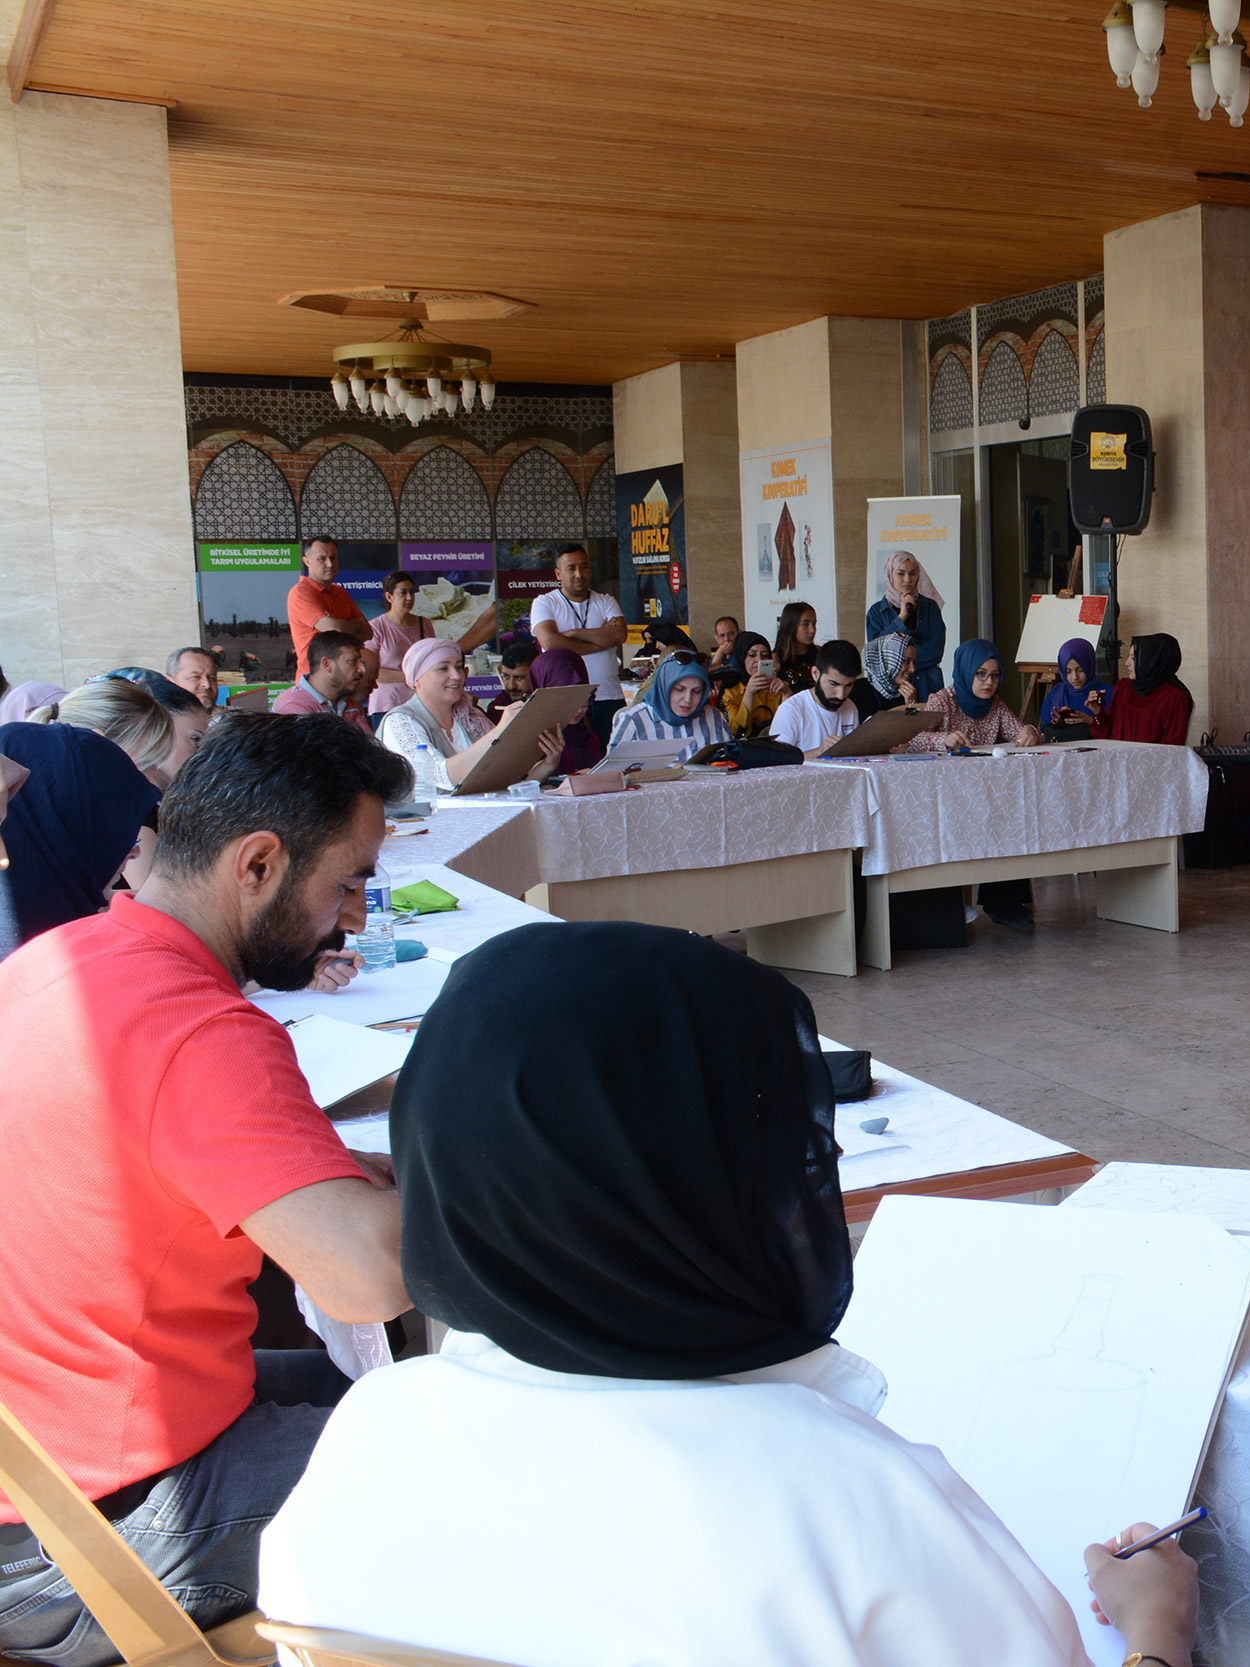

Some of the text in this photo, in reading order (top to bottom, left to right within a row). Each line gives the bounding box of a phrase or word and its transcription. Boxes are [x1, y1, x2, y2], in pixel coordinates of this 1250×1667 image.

[771, 458, 797, 478] KOMEK
[762, 474, 808, 501] KOOPERATİFİ
[895, 513, 933, 527] KOMEK
[631, 527, 670, 555] HUFFAZ
[880, 525, 948, 543] KOOPERATİFİ
[210, 547, 291, 556] BİTKİSEL ÜRETİMDE İYİ
[410, 553, 432, 561] BEYAZ
[458, 552, 485, 560] ÜRETİMİ
[508, 581, 528, 590] ÇİLEK
